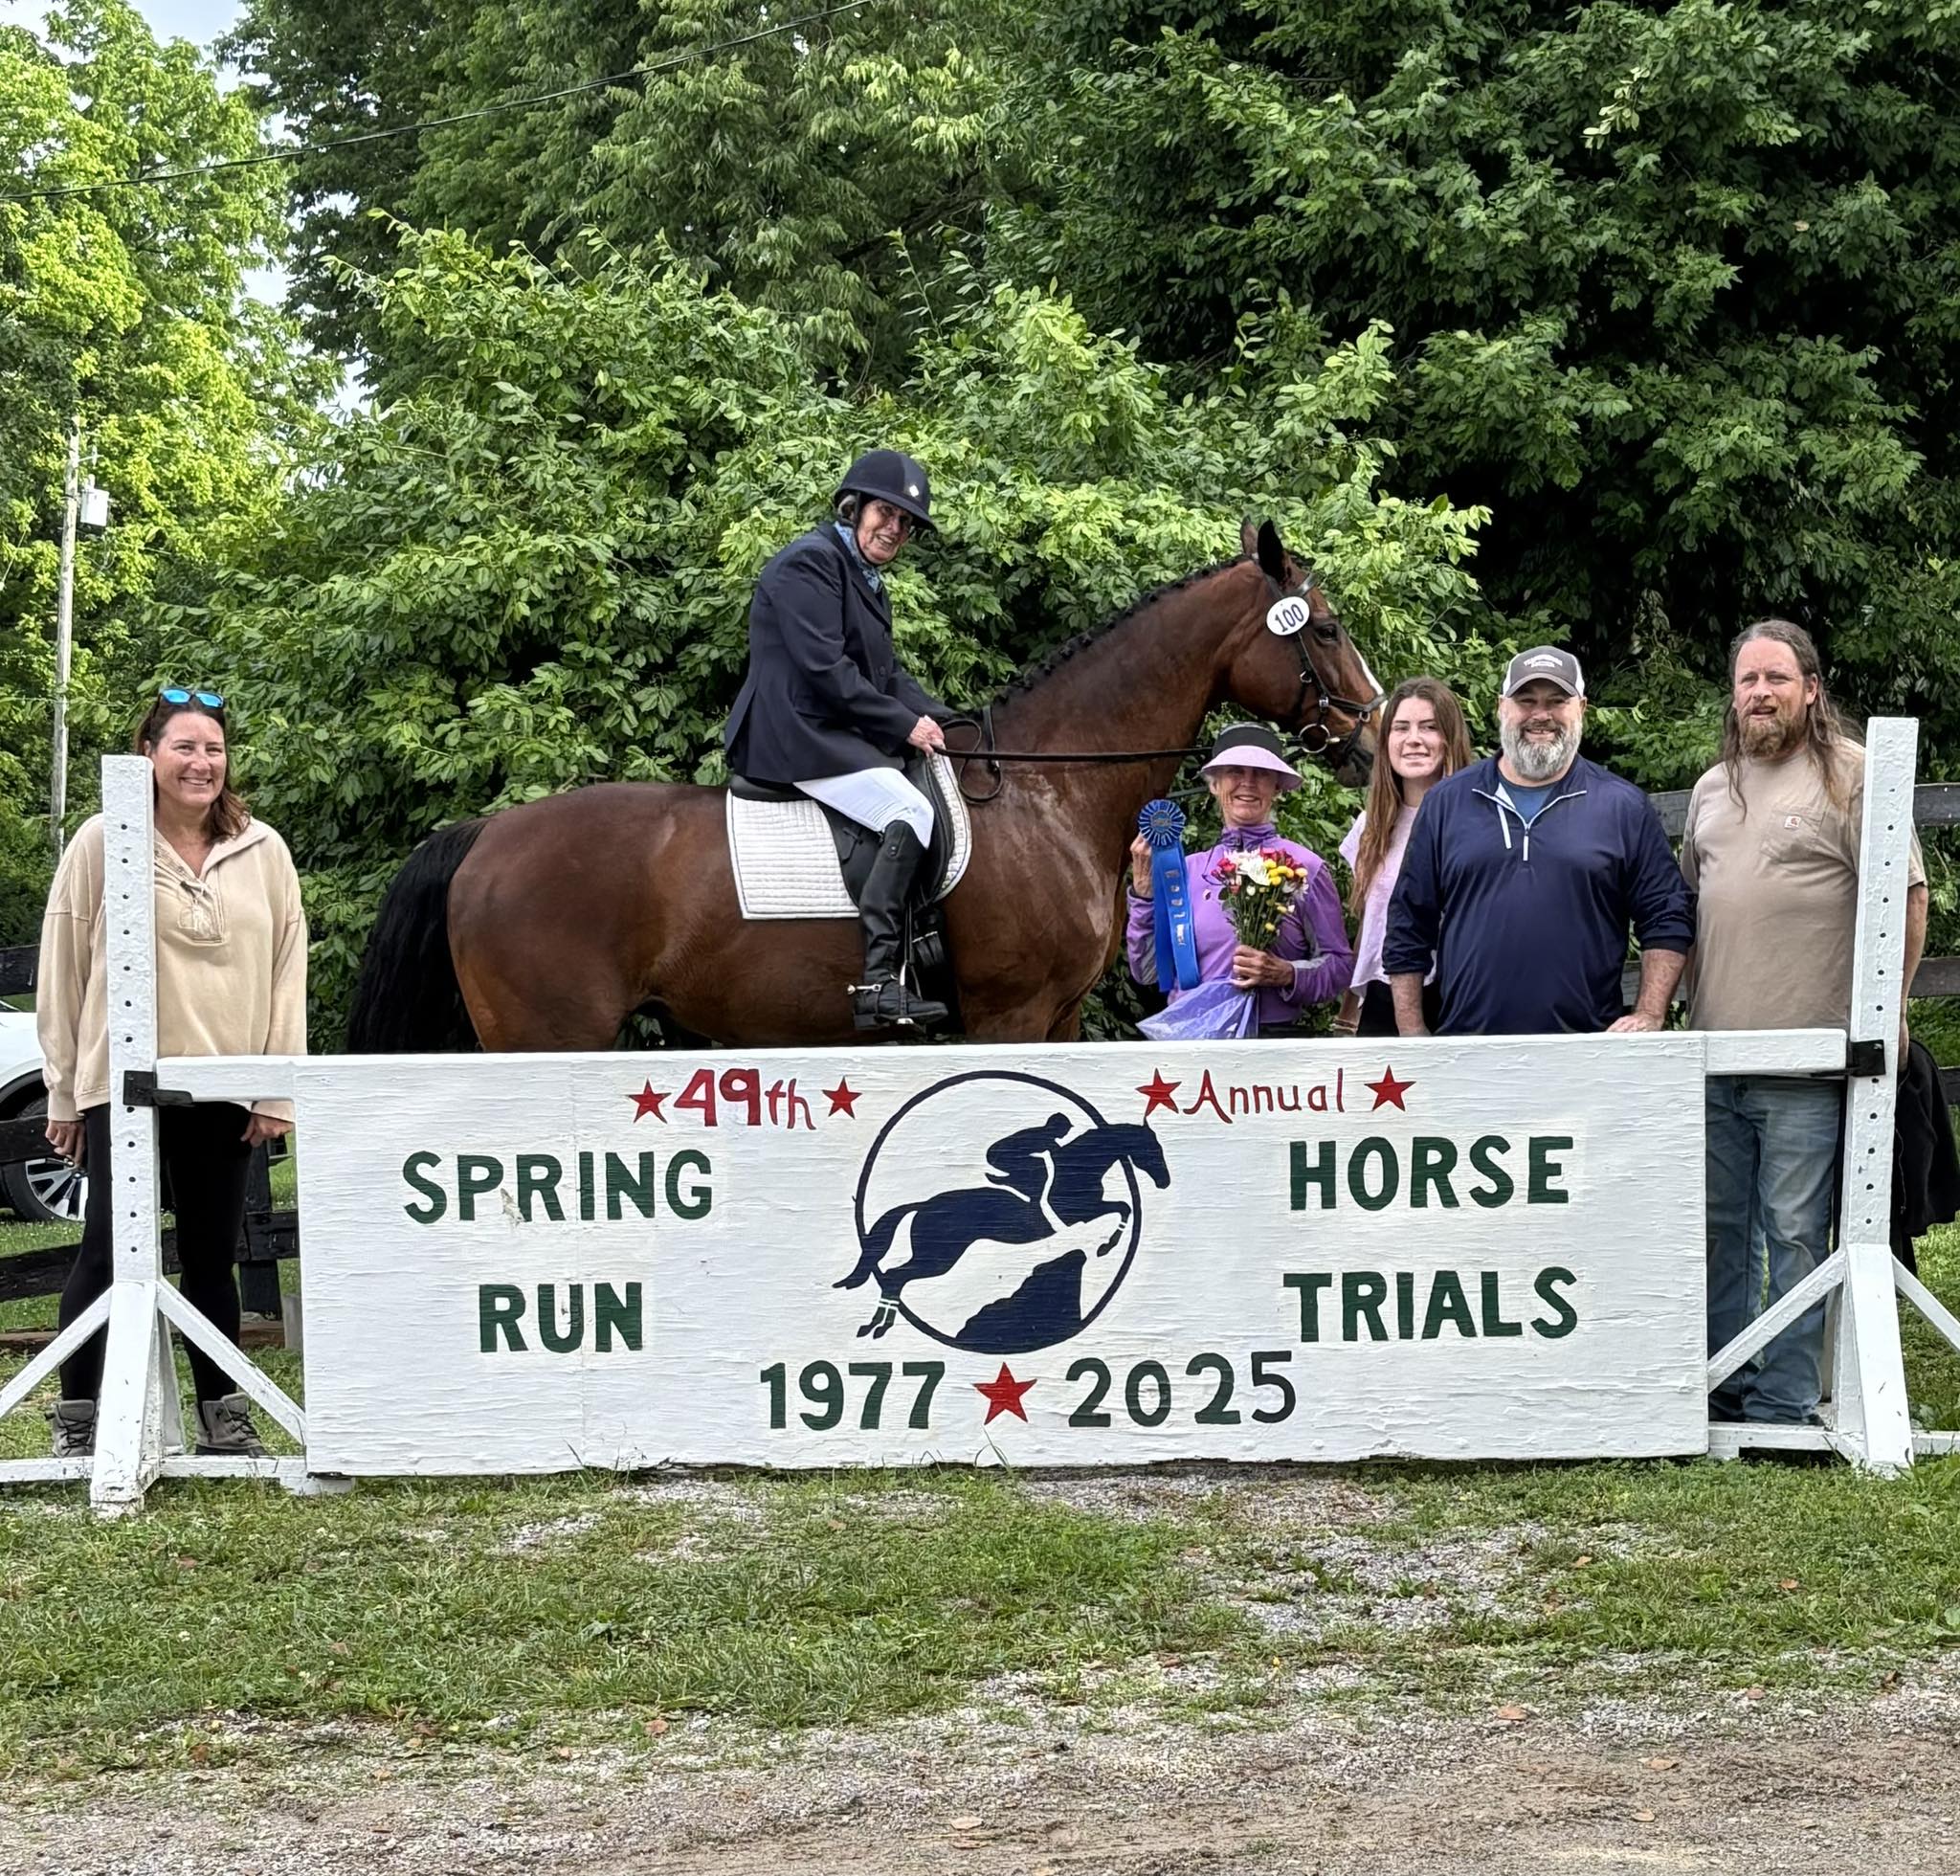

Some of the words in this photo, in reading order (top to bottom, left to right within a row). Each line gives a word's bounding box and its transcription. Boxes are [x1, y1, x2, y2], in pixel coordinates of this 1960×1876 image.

[1275, 603, 1304, 633] 100
[674, 1068, 816, 1130] 49th
[1182, 1067, 1346, 1124] Annual
[402, 1149, 713, 1225] SPRING
[1289, 1134, 1574, 1212] HORSE
[479, 1282, 644, 1354] RUN
[1282, 1266, 1578, 1344] TRIALS
[760, 1359, 946, 1432] 1977
[1065, 1350, 1297, 1428] 2025
